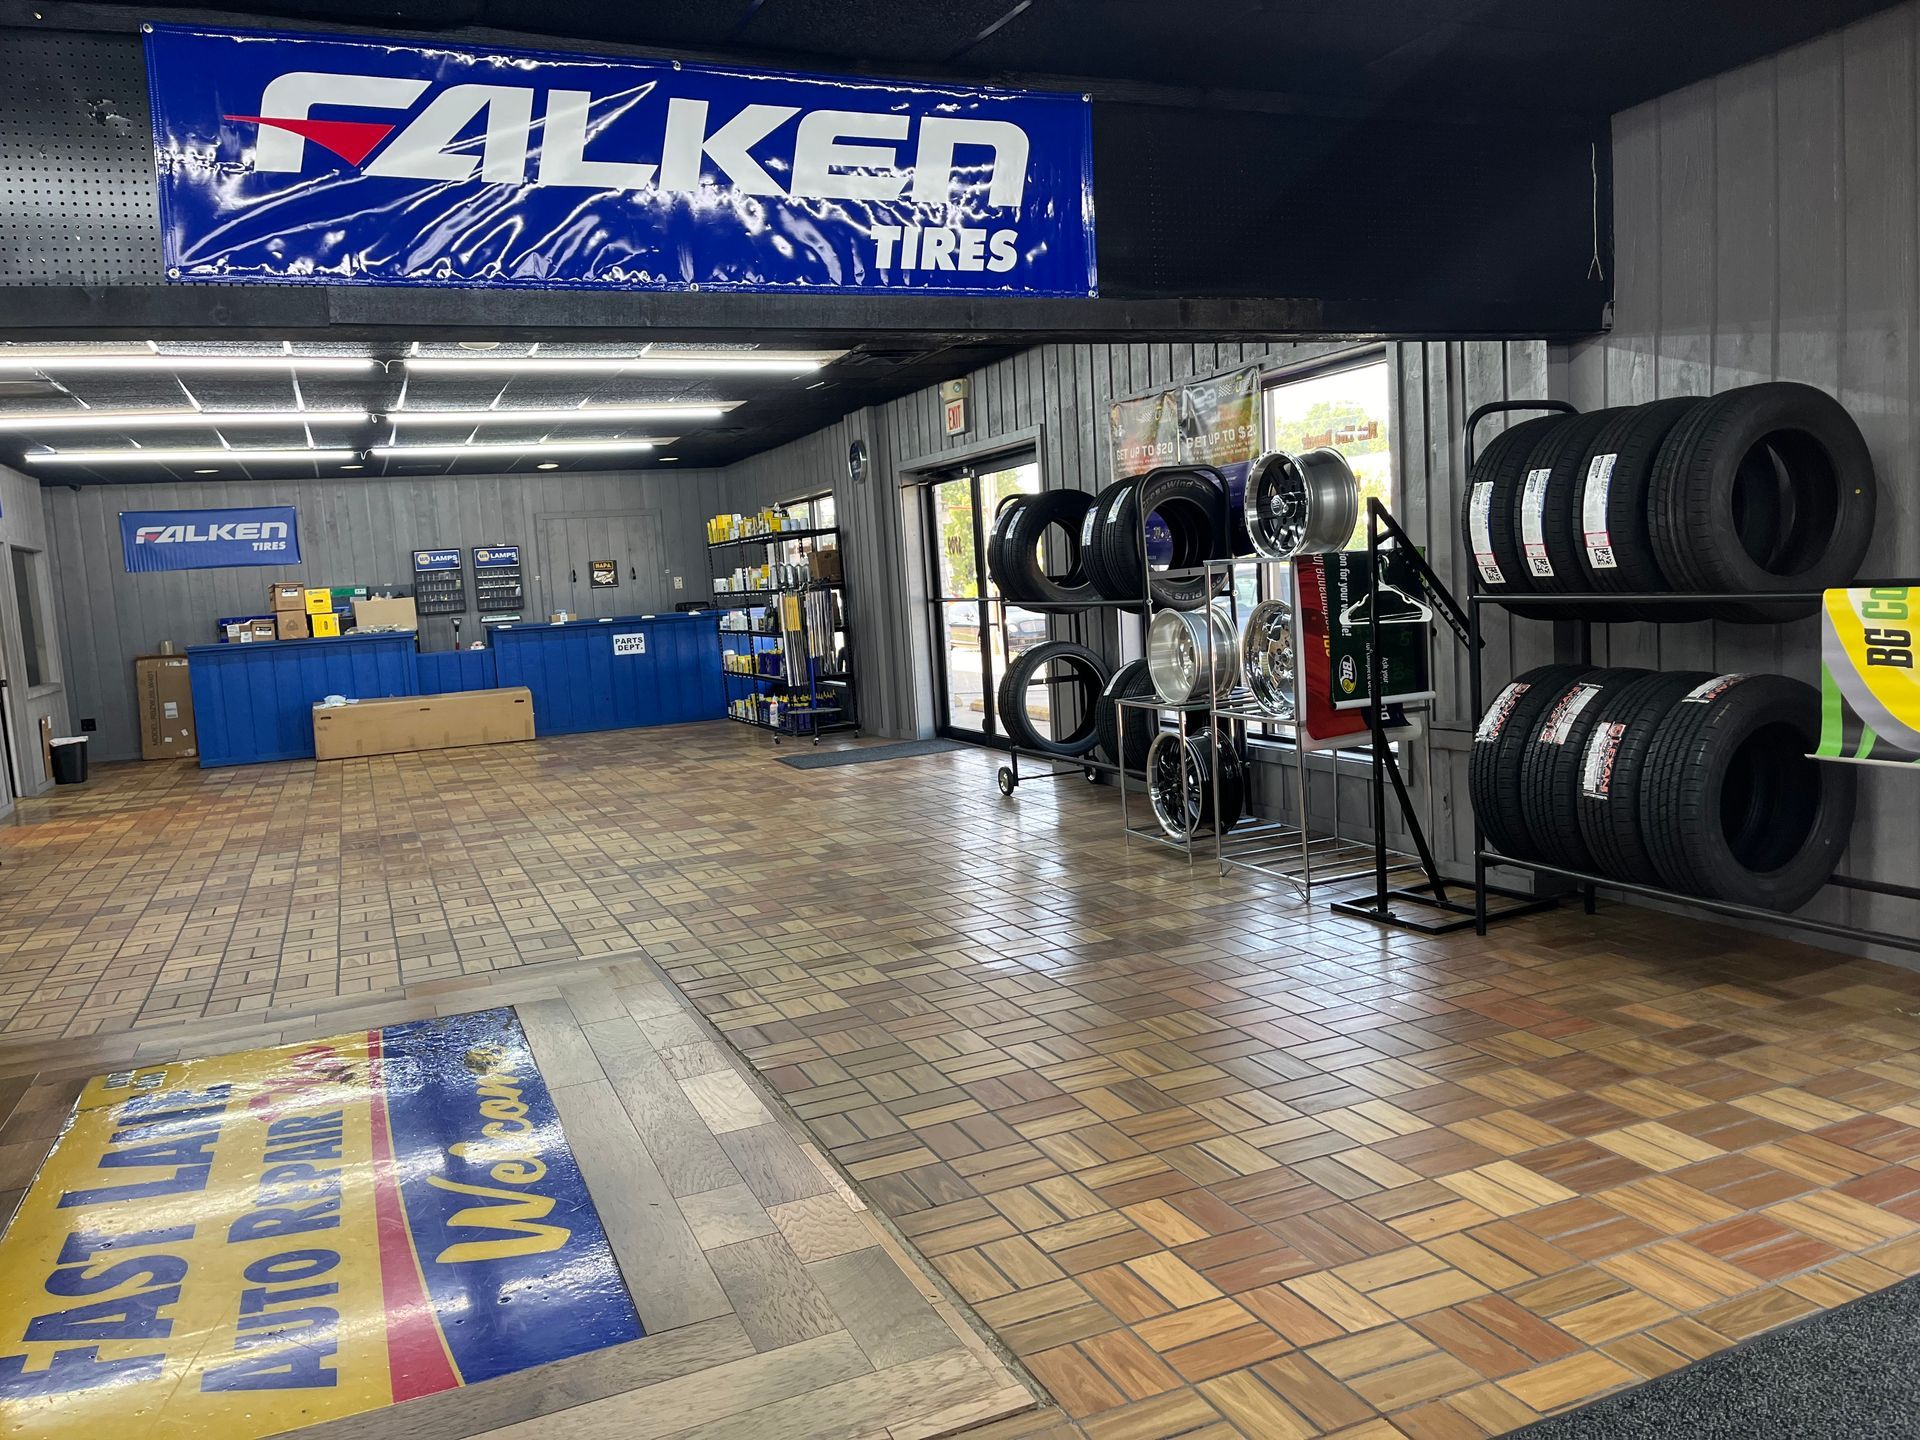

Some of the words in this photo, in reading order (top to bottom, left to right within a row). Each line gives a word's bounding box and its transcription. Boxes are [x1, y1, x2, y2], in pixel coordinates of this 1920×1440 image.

[225, 71, 1030, 208] FALKEN
[871, 224, 1018, 272] TIRES
[947, 404, 961, 431] EXIT
[1208, 432, 1220, 445] UP
[1222, 429, 1235, 442] TO
[1130, 446, 1140, 459] UP
[1142, 445, 1155, 457] TO
[1156, 441, 1174, 456] $20
[135, 521, 288, 545] FALKEN
[251, 541, 286, 551] TIRES
[490, 551, 517, 560] LAMPS
[431, 554, 458, 563] LAMPS
[1339, 567, 1351, 581] for
[1338, 582, 1349, 602] your
[615, 636, 643, 645] PARTS
[617, 643, 644, 652] DEPT.
[1864, 627, 1914, 669] BG
[426, 1044, 572, 1264] Welcome
[227, 1110, 344, 1244] REPAIR
[0, 1221, 196, 1400] FAST
[201, 1249, 341, 1393] AUTO
